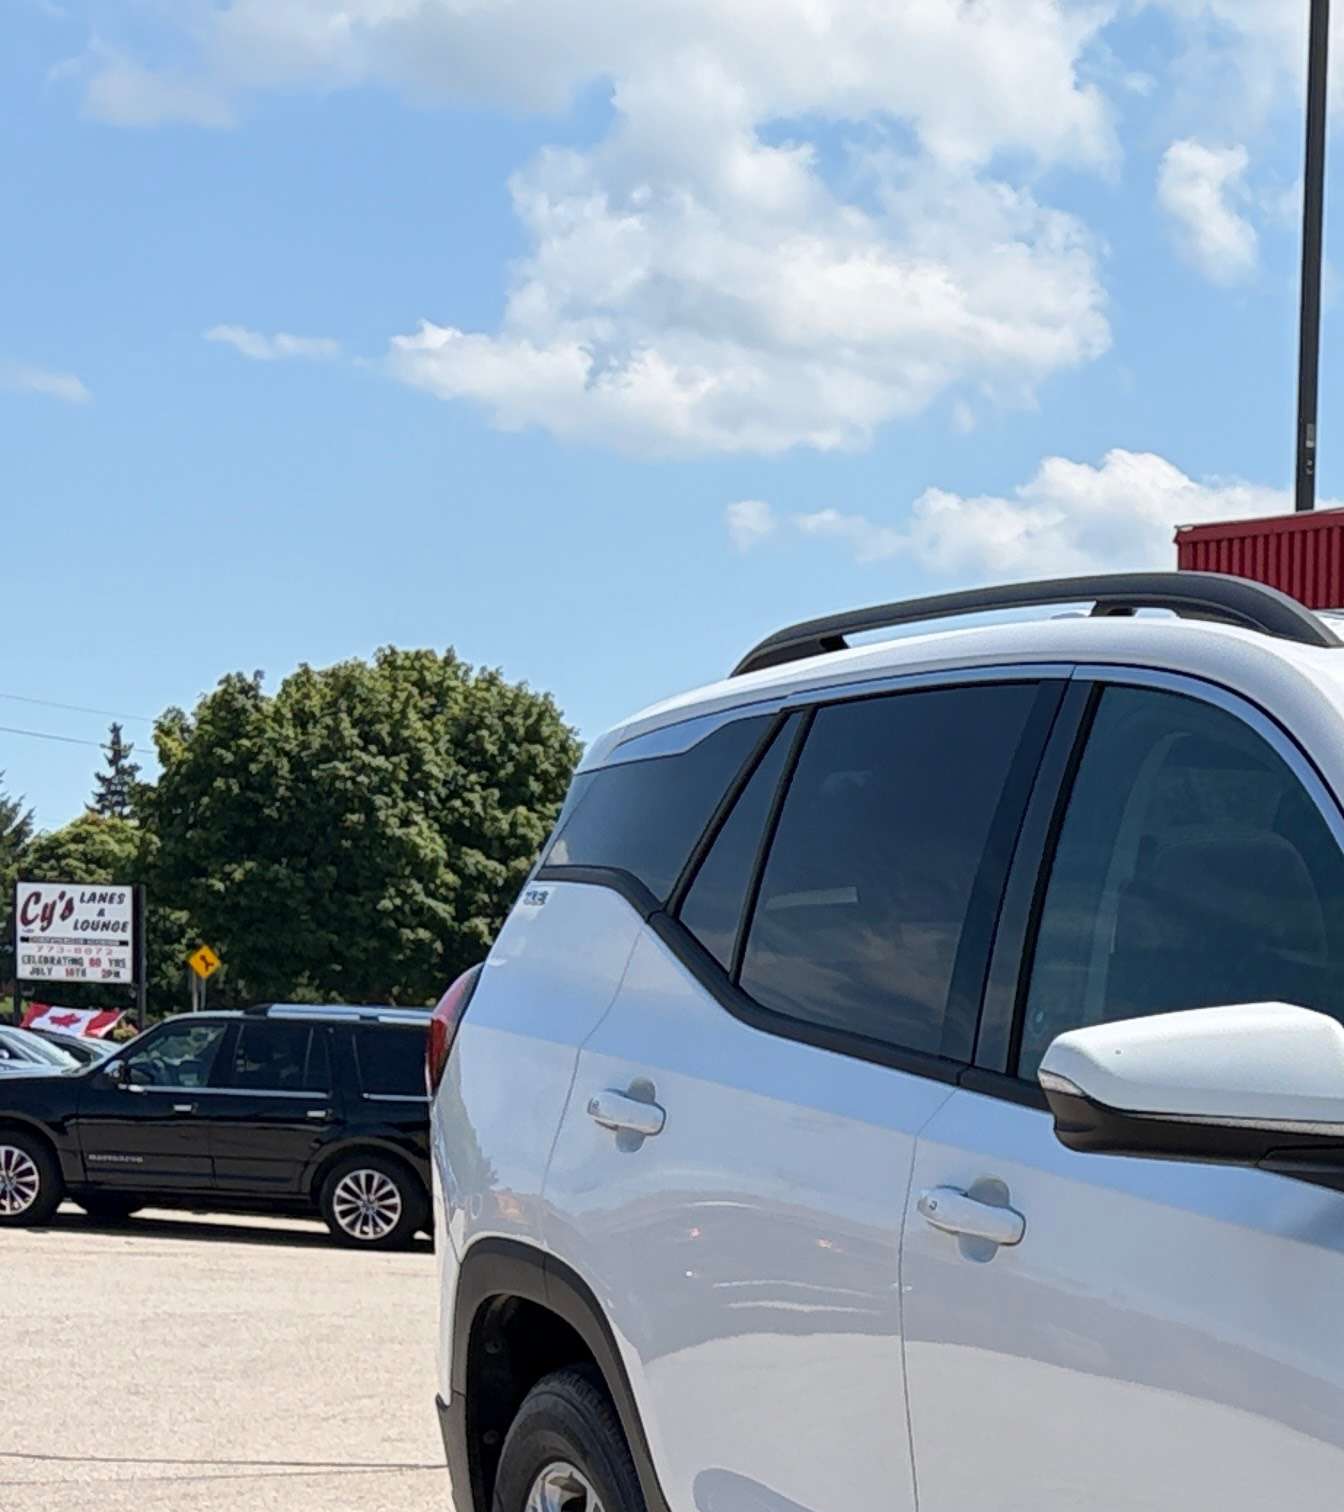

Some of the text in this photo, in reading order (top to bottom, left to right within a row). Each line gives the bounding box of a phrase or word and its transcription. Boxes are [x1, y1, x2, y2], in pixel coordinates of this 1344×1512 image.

[80, 891, 126, 904] LANES
[20, 891, 75, 932] Cy's
[97, 908, 105, 917] &
[73, 919, 129, 933] LOUNGE
